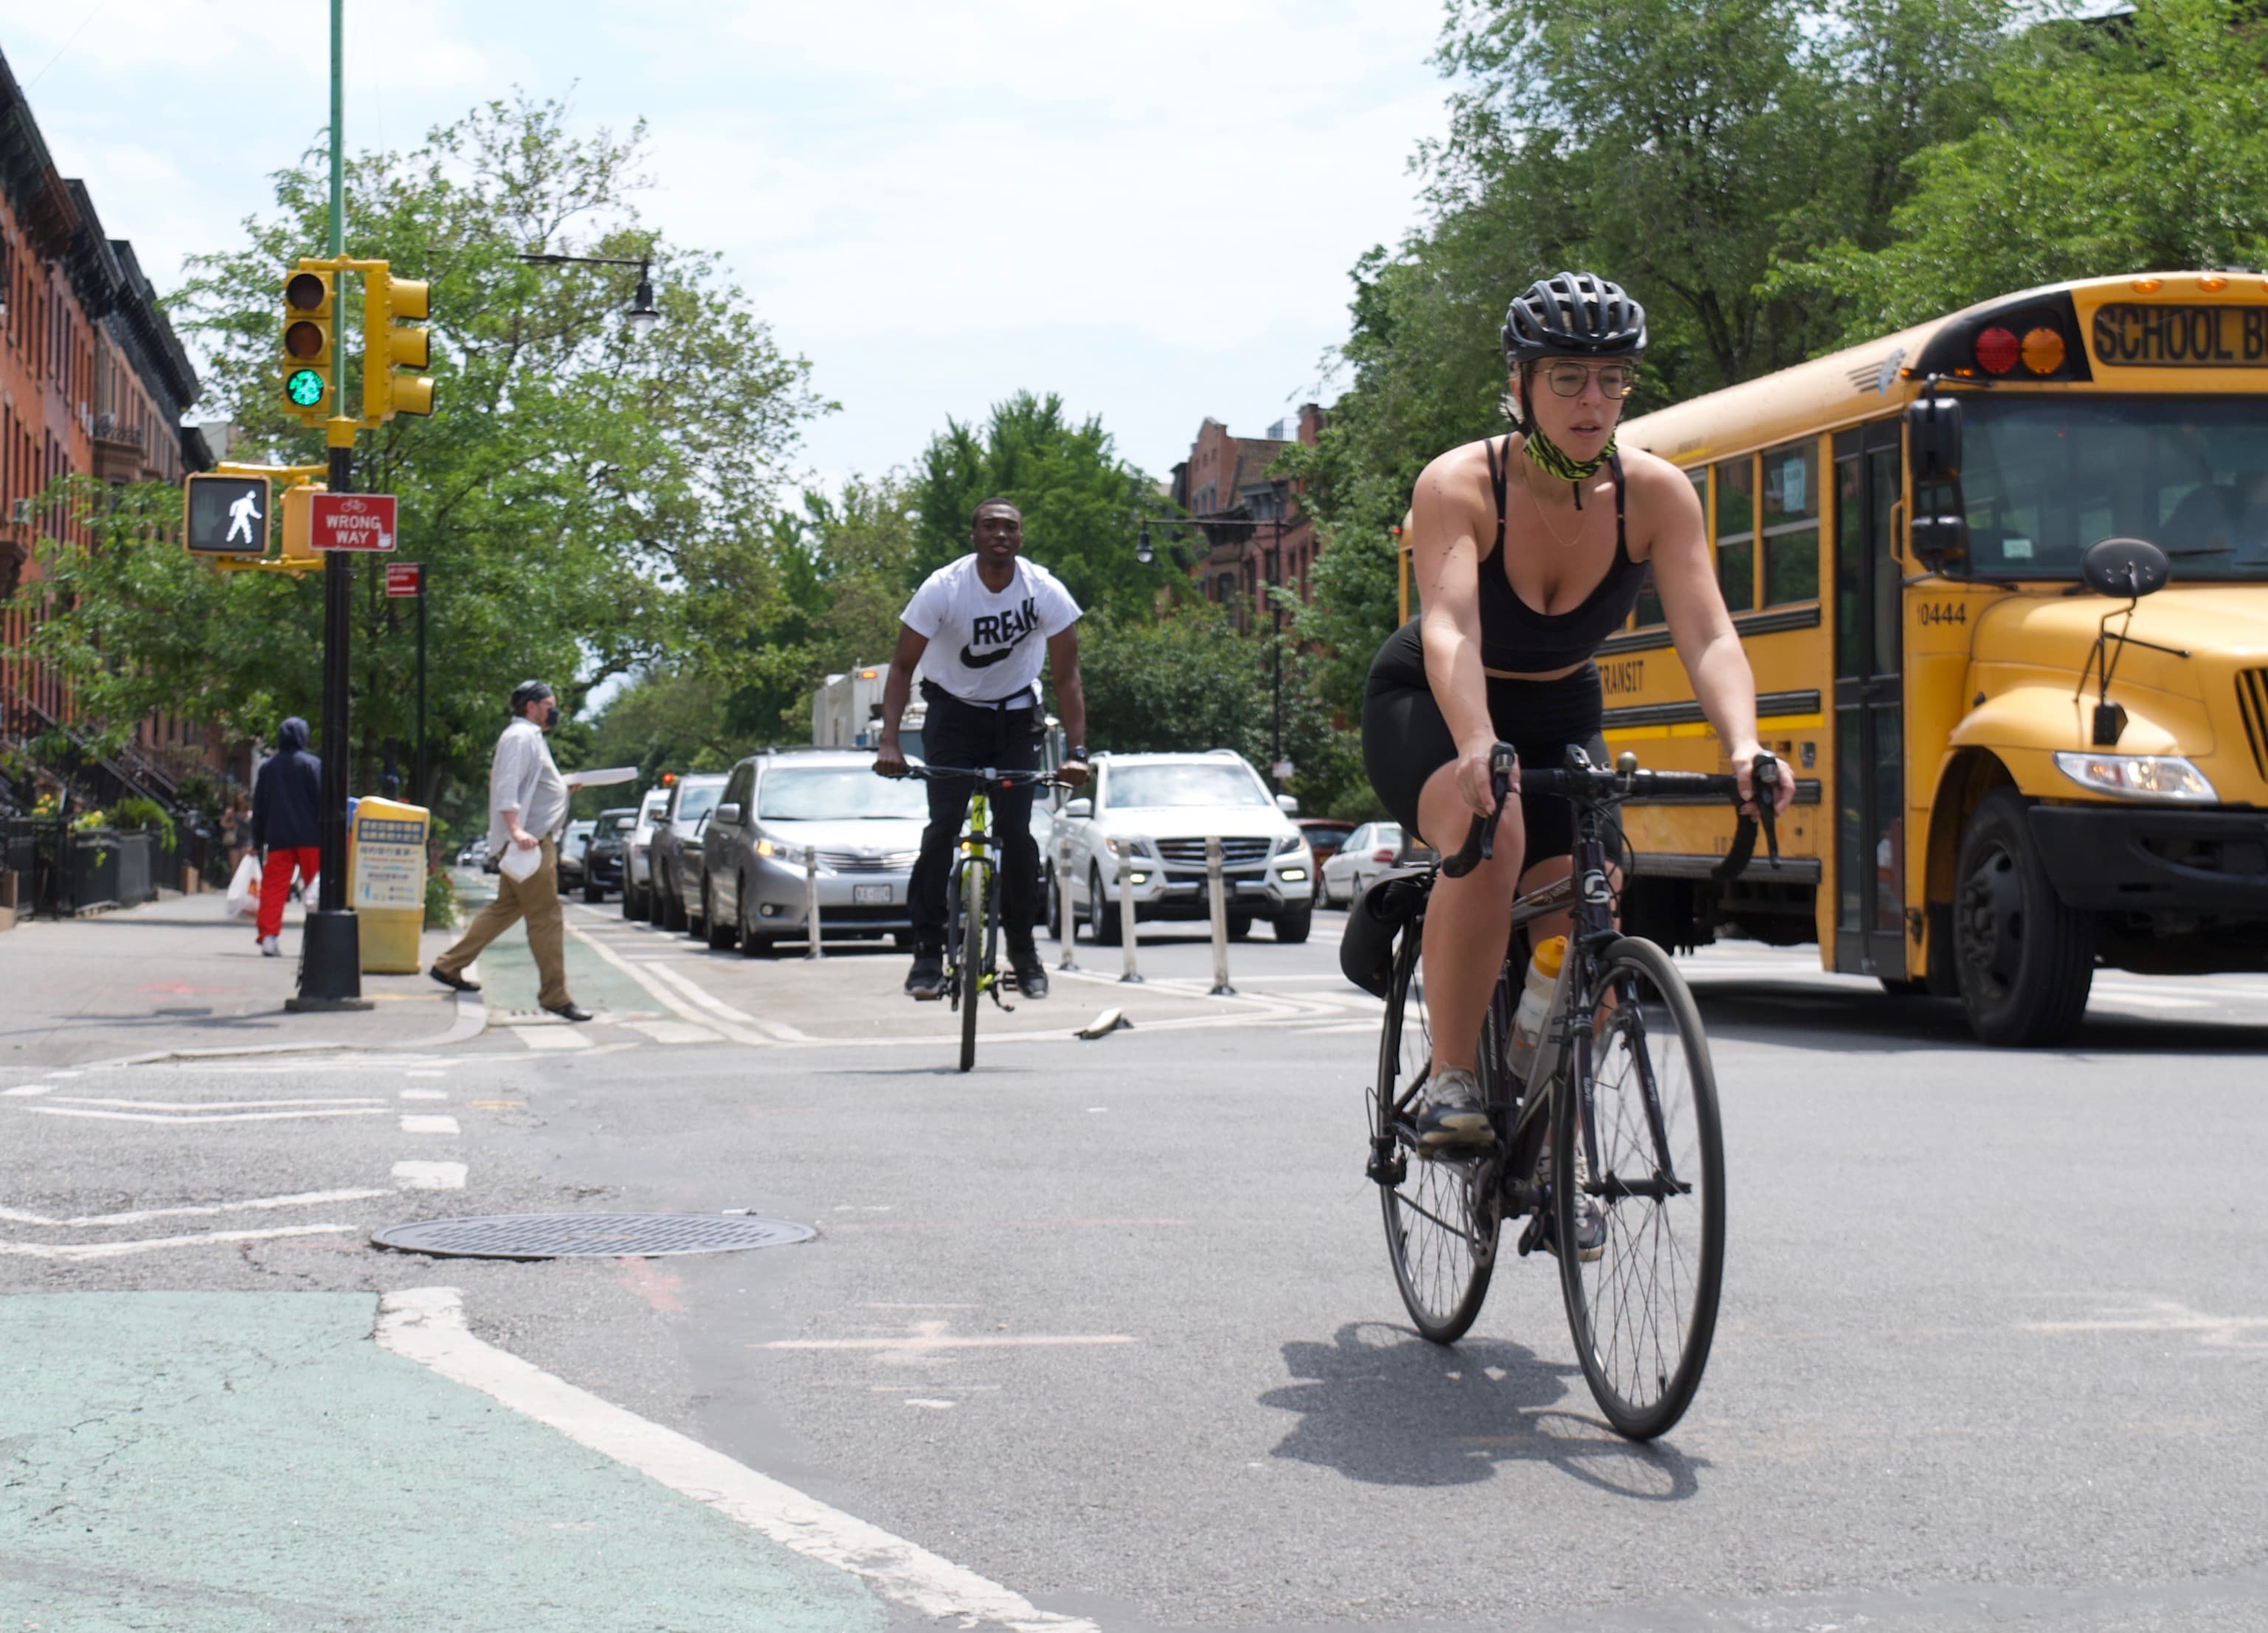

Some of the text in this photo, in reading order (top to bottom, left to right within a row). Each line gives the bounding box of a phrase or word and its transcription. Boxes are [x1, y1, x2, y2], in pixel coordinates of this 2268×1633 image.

[2095, 307, 2234, 360] SCHOOL
[325, 514, 381, 530] WRONG
[336, 531, 369, 545] WAY
[972, 596, 1040, 646] FREAK
[1599, 660, 1645, 696] TRANSIT
